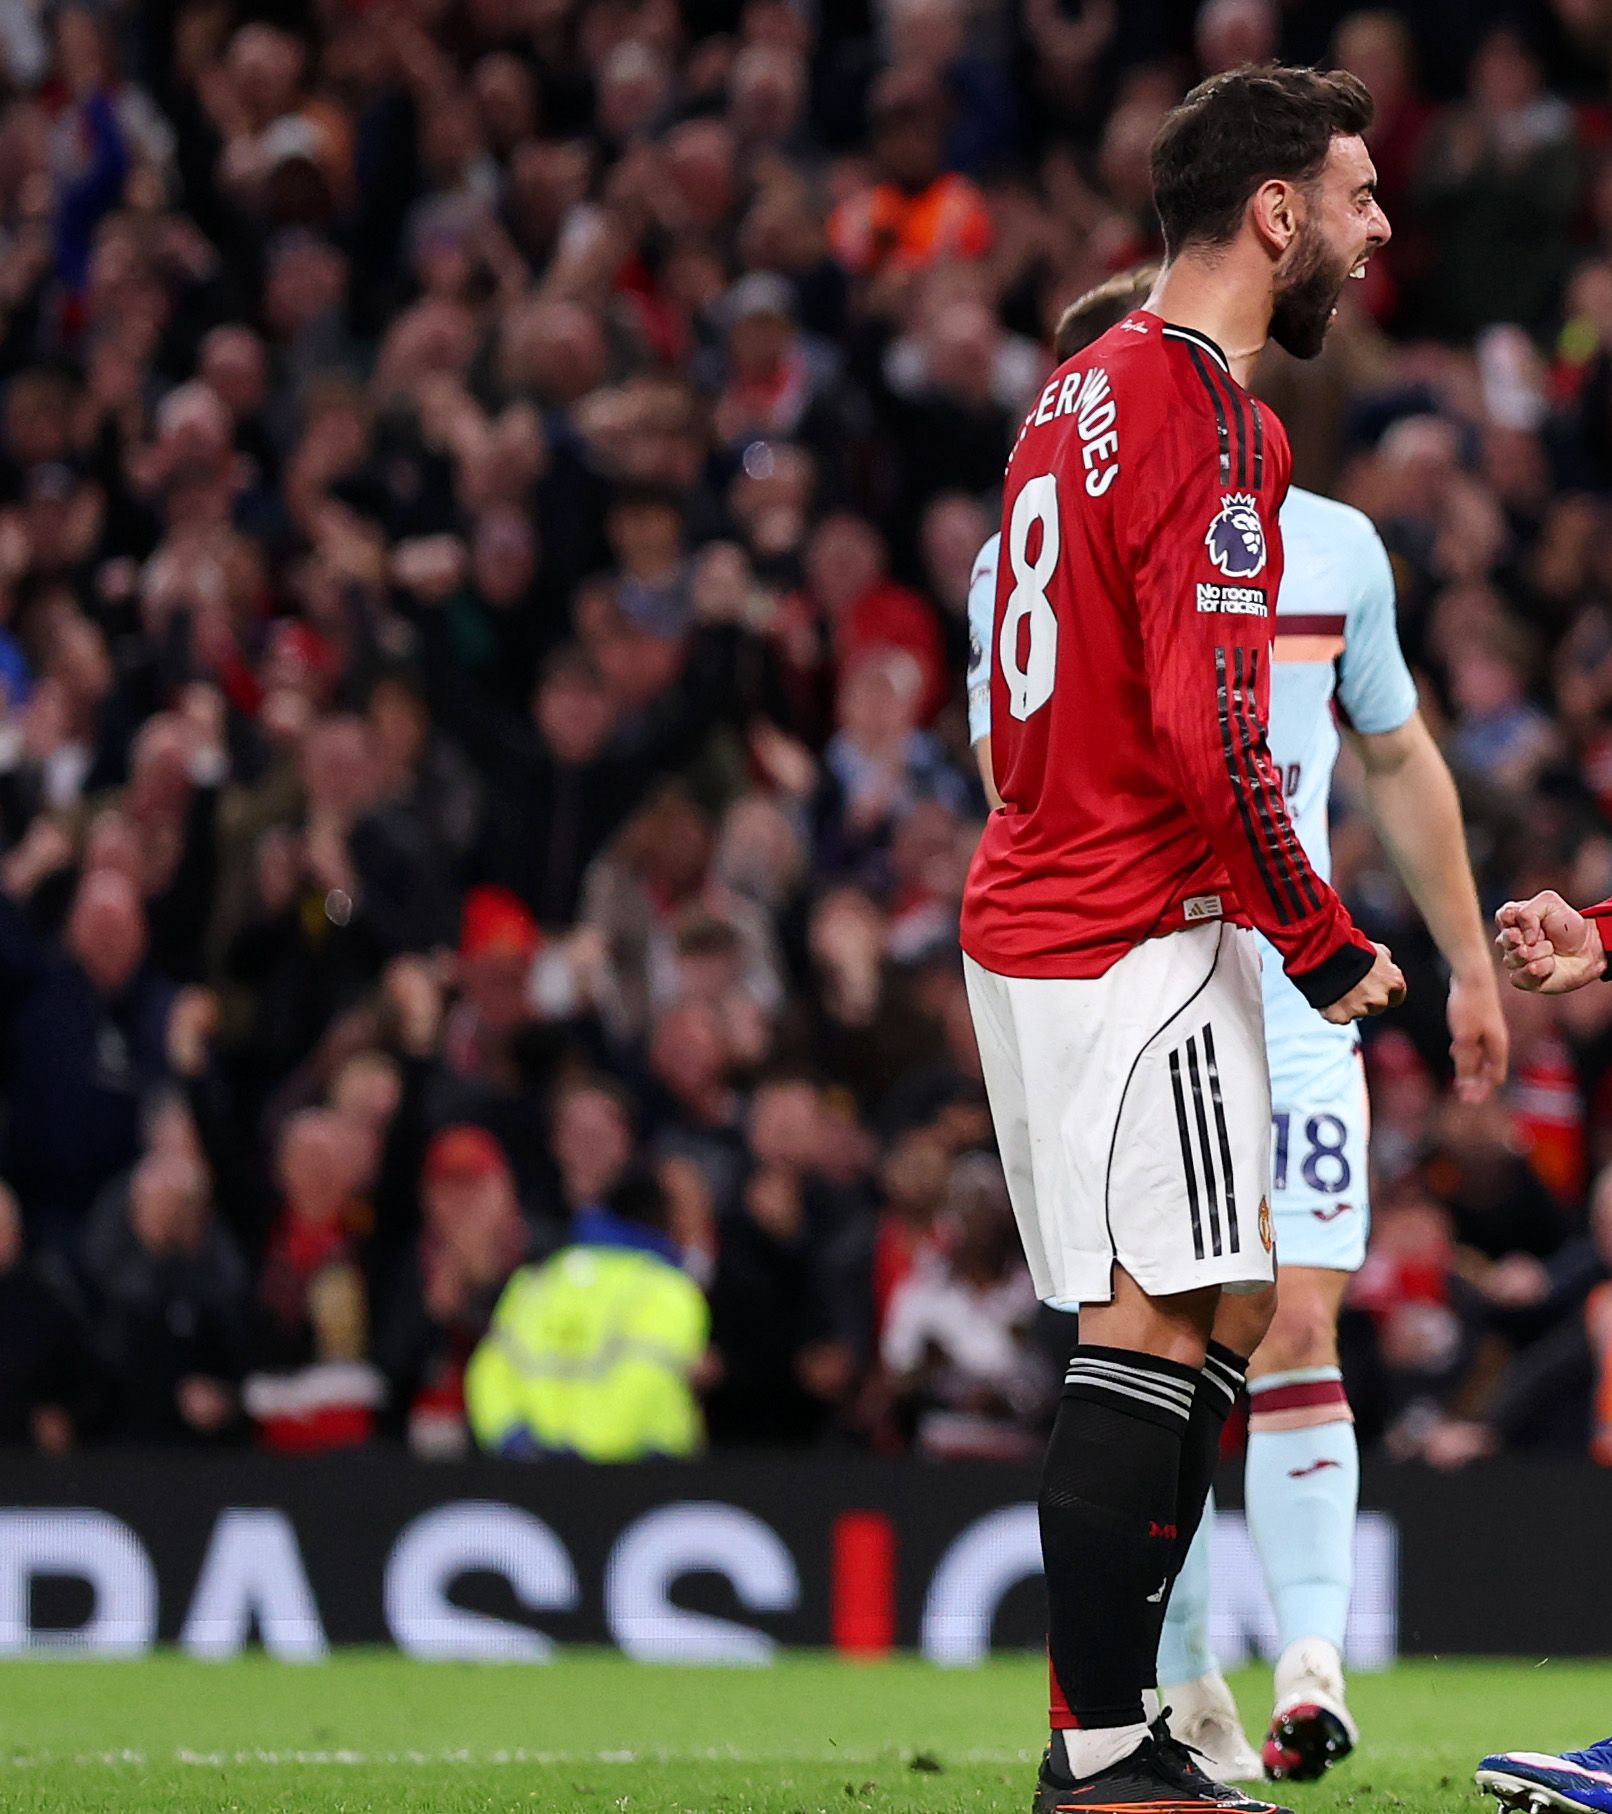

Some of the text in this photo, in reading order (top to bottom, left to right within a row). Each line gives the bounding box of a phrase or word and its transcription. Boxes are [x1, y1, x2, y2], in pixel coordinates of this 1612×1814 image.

[1000, 472, 1060, 722] 8
[1196, 583, 1263, 603] No room
[1221, 600, 1268, 617] racism
[1272, 1112, 1351, 1193] 18
